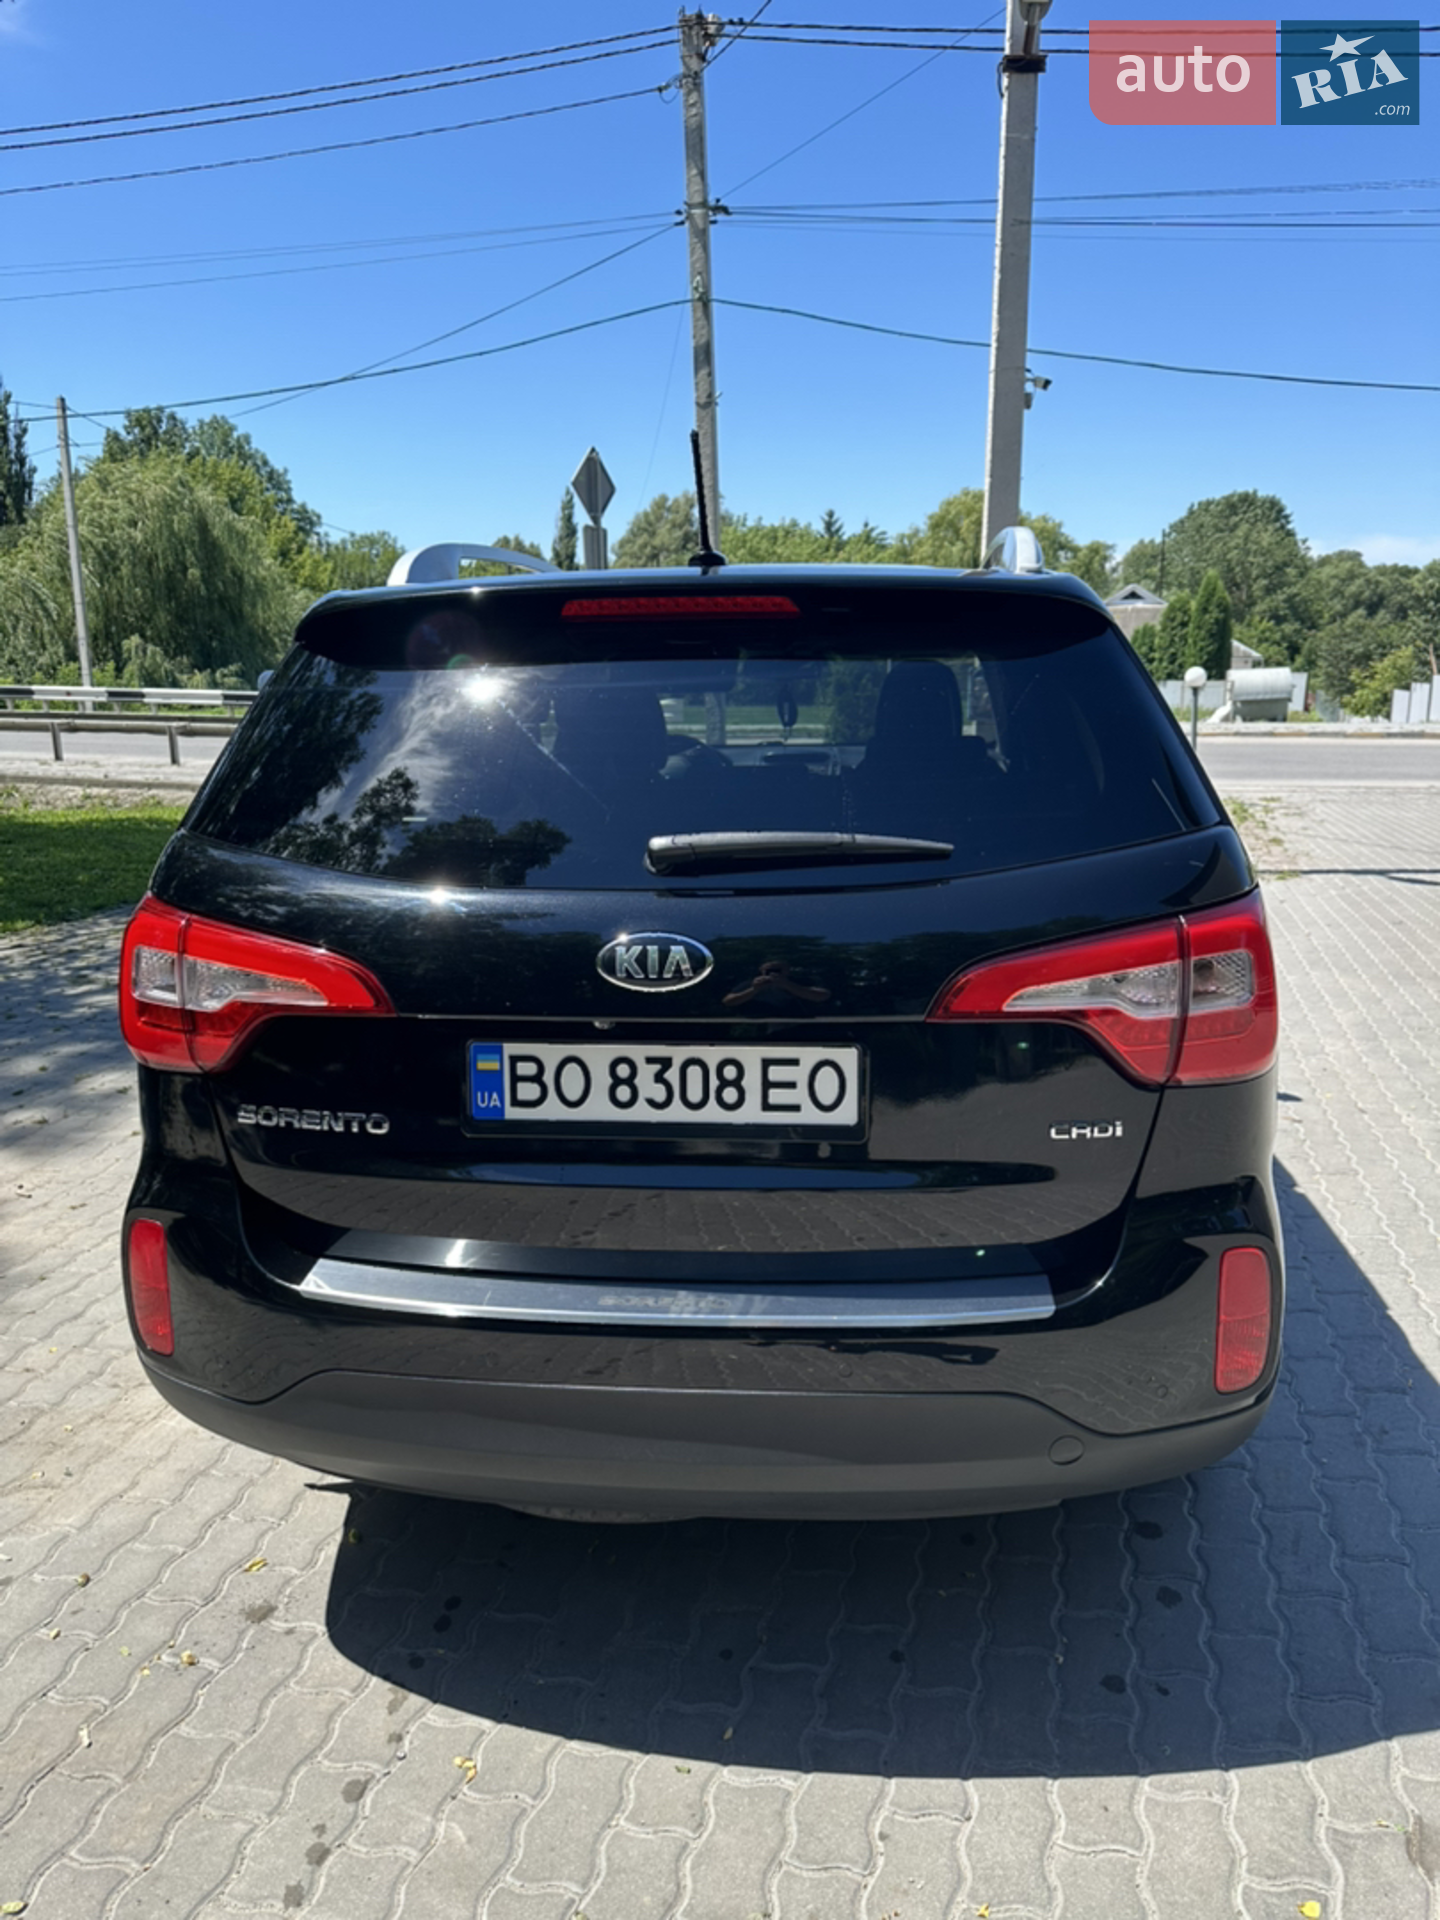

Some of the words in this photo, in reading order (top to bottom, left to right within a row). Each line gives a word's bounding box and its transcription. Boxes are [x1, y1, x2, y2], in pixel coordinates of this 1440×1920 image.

[614, 944, 694, 979] KIA
[476, 1090, 502, 1109] UA
[508, 1054, 592, 1109] BO
[607, 1056, 747, 1112] 8308
[760, 1058, 847, 1114] EO
[237, 1103, 390, 1135] SORENTO
[1049, 1120, 1123, 1140] CRDi
